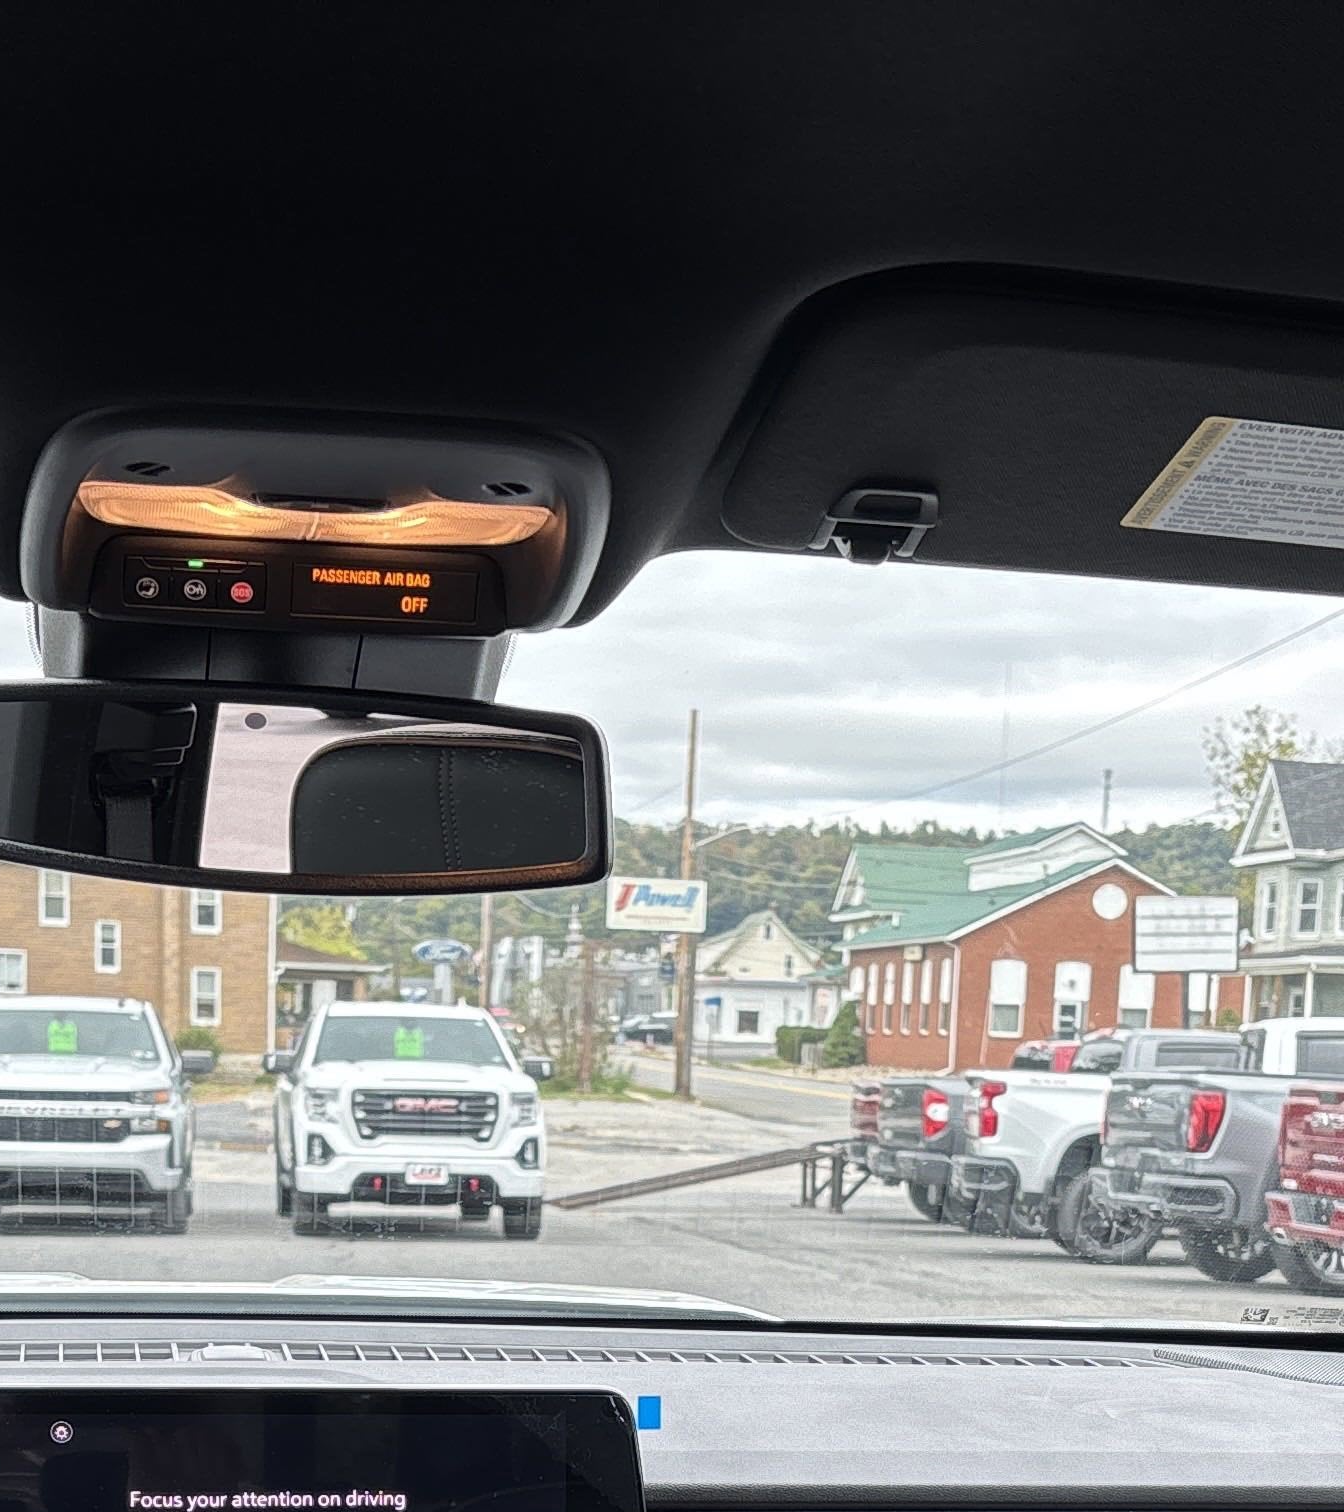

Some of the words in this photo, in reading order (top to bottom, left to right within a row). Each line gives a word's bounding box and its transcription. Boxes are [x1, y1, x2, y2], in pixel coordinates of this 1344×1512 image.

[1238, 422, 1278, 433] EVEN
[1278, 427, 1316, 437] WITH
[1237, 478, 1271, 489] AVEC
[1271, 482, 1297, 491] DES
[1298, 485, 1334, 495] SACS
[312, 568, 380, 585] PASSENGER
[383, 572, 404, 586] AIR
[405, 572, 430, 588] BAG
[401, 596, 428, 613] OFF
[129, 1490, 183, 1508] Focus
[186, 1493, 228, 1512] your
[231, 1490, 313, 1508] attention
[317, 1494, 341, 1507] on
[346, 1489, 406, 1511] driving
